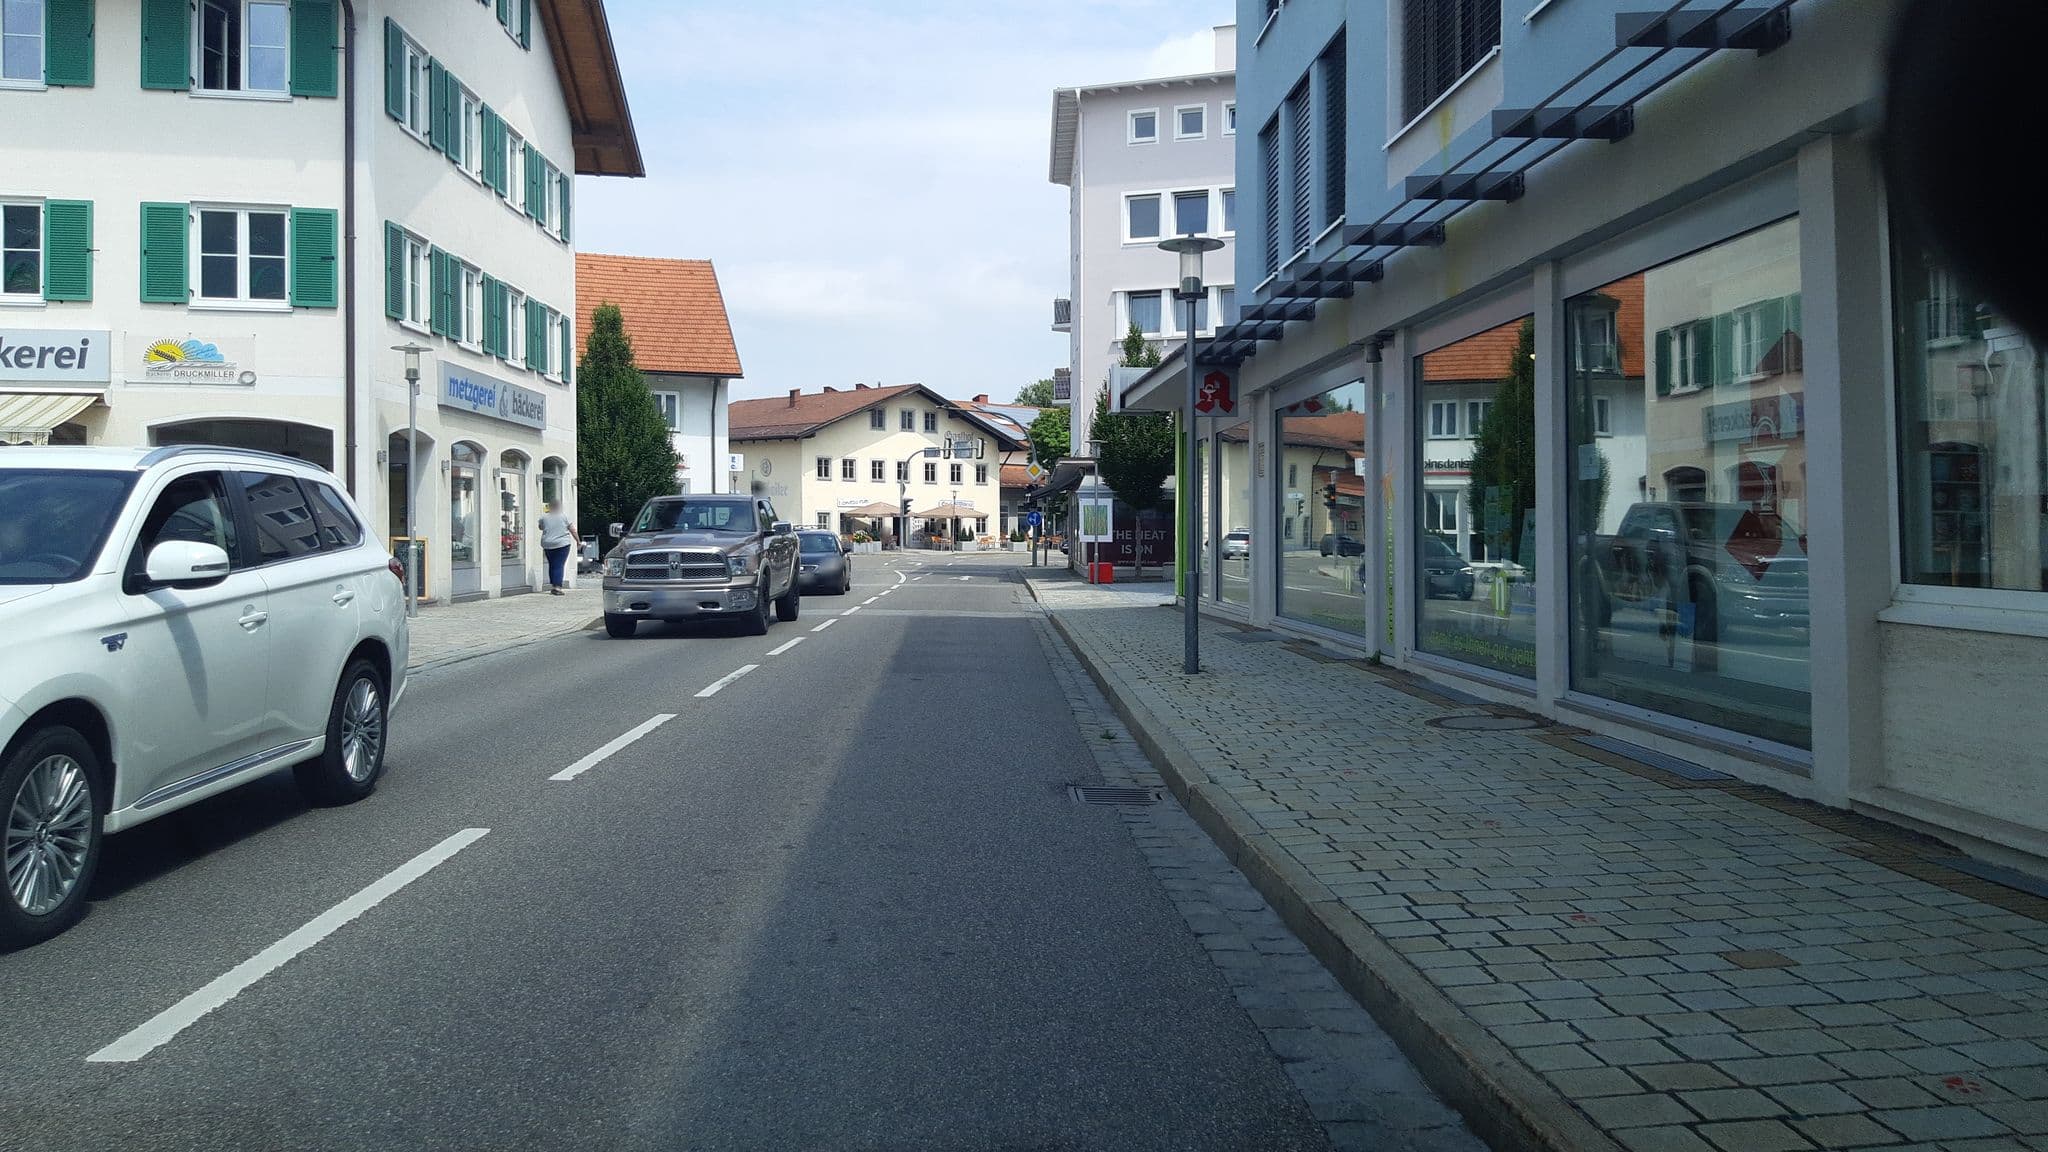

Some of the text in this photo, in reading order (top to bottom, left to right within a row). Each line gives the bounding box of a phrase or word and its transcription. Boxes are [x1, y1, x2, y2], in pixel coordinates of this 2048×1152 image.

[0, 337, 89, 369] kerei
[174, 370, 235, 378] DRUCKMILLER
[449, 376, 544, 421] metzgerei & bäckerei
[1121, 545, 1132, 554] IS
